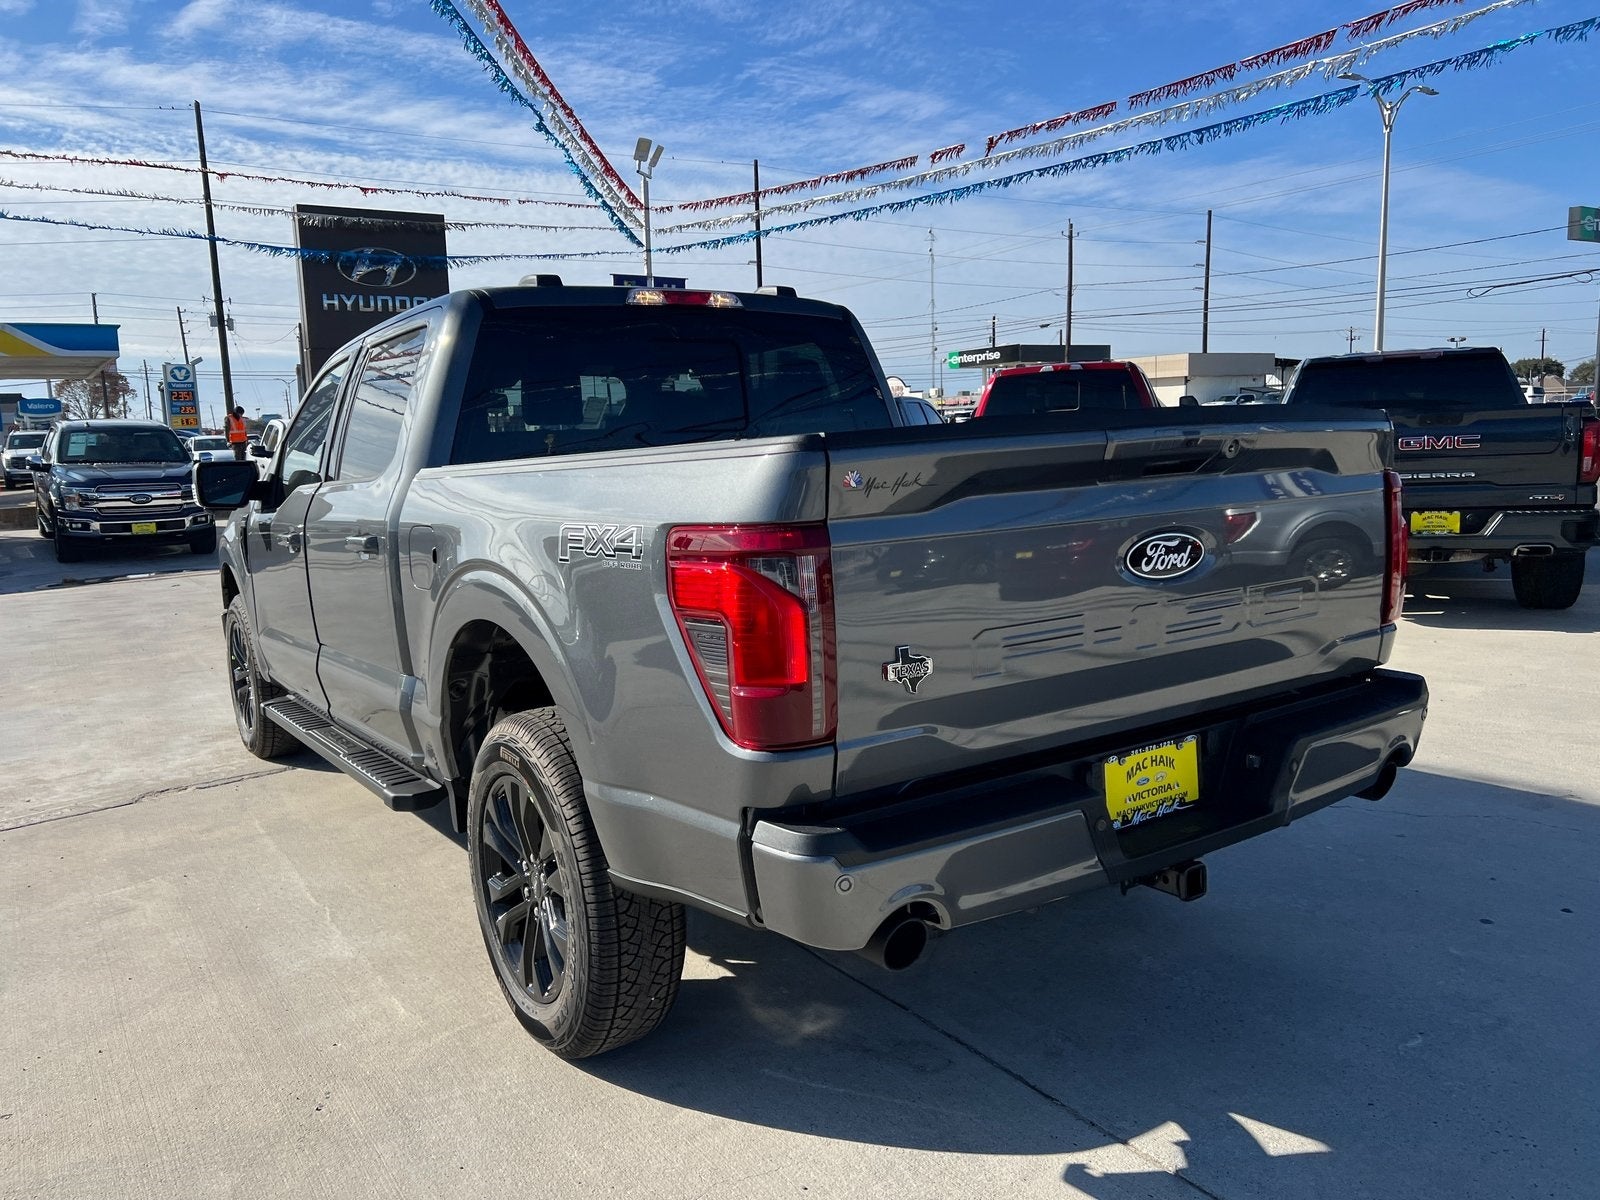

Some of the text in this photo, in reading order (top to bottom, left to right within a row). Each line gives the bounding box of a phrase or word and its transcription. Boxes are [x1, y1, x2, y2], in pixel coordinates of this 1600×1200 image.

[322, 293, 434, 312] HYUNDA
[949, 350, 1001, 365] enterprise
[1399, 435, 1480, 450] GMC
[1399, 471, 1475, 479] SIERRA
[863, 472, 931, 498] Mac Haik
[558, 523, 644, 563] FX4
[1141, 538, 1192, 572] Ford
[602, 560, 642, 571] OFF ROAD
[697, 633, 726, 641] FORD
[891, 661, 930, 678] TEXAS
[1126, 754, 1176, 783] MAC HAIK
[1131, 783, 1173, 802] VICTORIA
[1131, 799, 1188, 825] Mac Haik
